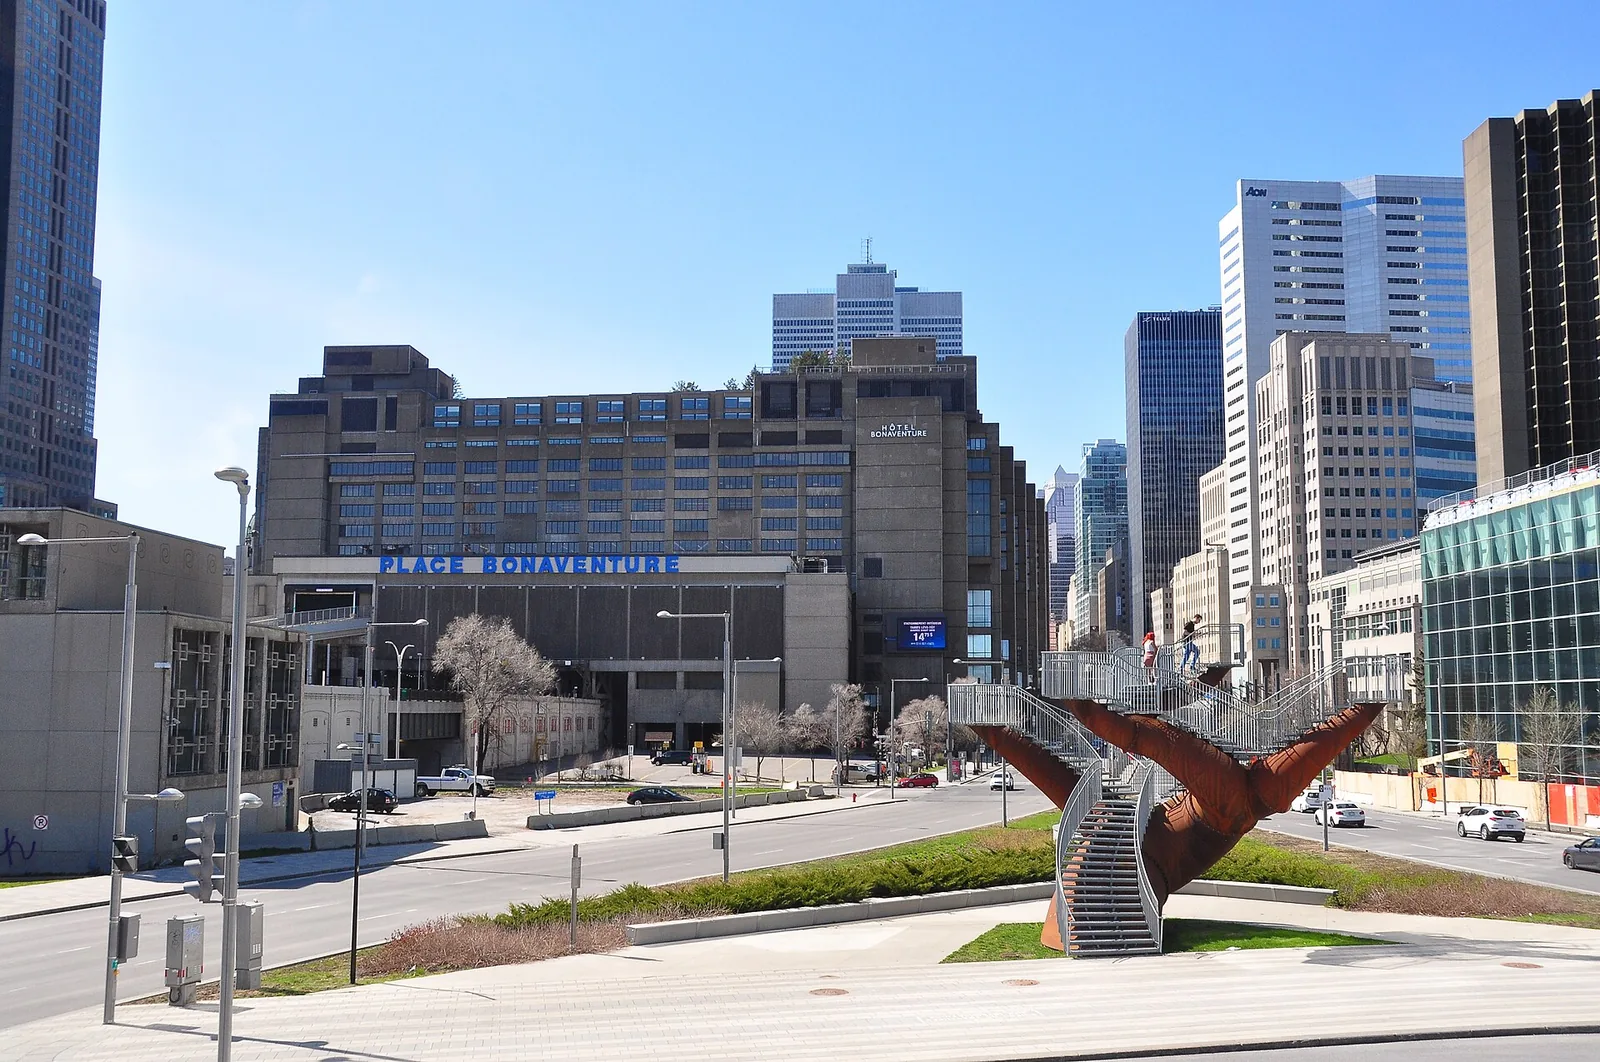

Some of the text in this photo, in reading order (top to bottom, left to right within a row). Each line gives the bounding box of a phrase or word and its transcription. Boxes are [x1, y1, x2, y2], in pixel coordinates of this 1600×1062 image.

[881, 423, 915, 431] HÔTEL
[870, 430, 928, 438] BONAVENTURE
[379, 556, 680, 573] PLACE BONAVENTURE
